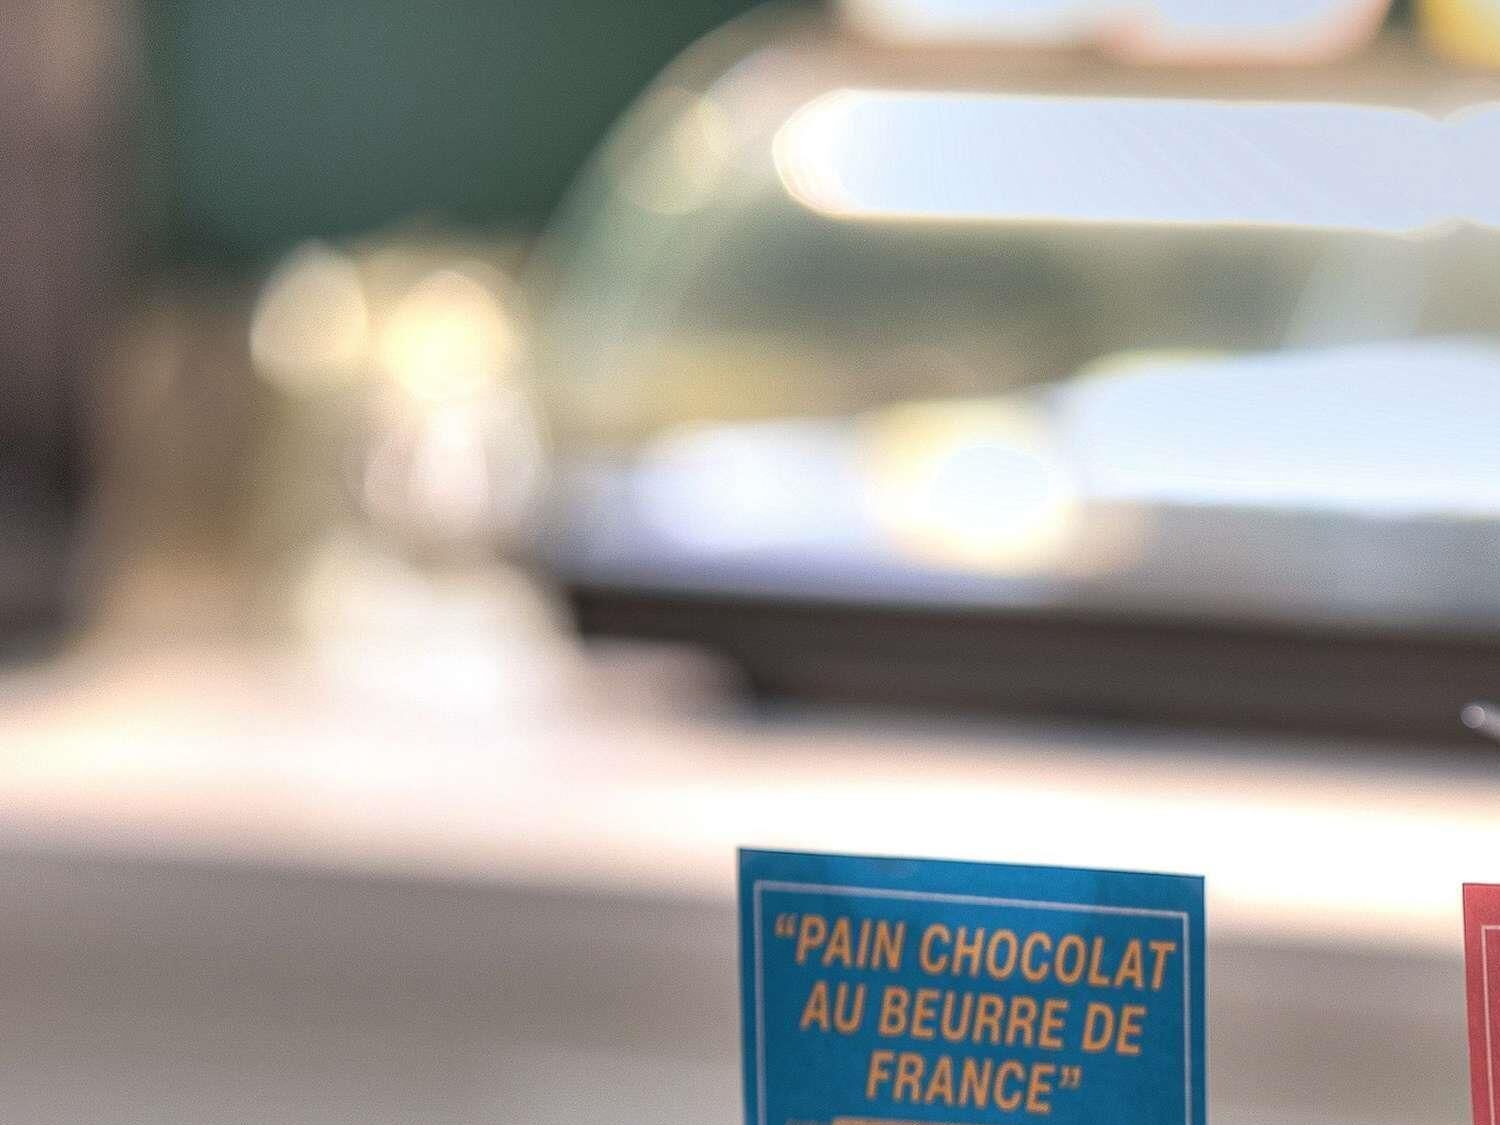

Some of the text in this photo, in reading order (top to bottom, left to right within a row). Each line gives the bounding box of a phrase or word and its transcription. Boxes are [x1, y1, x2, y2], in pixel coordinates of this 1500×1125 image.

[774, 913, 1175, 991] “PAIN CHOCOLAT
[800, 983, 1146, 1054] AU BEURRE DE
[865, 1052, 1081, 1114] FRANCE”
